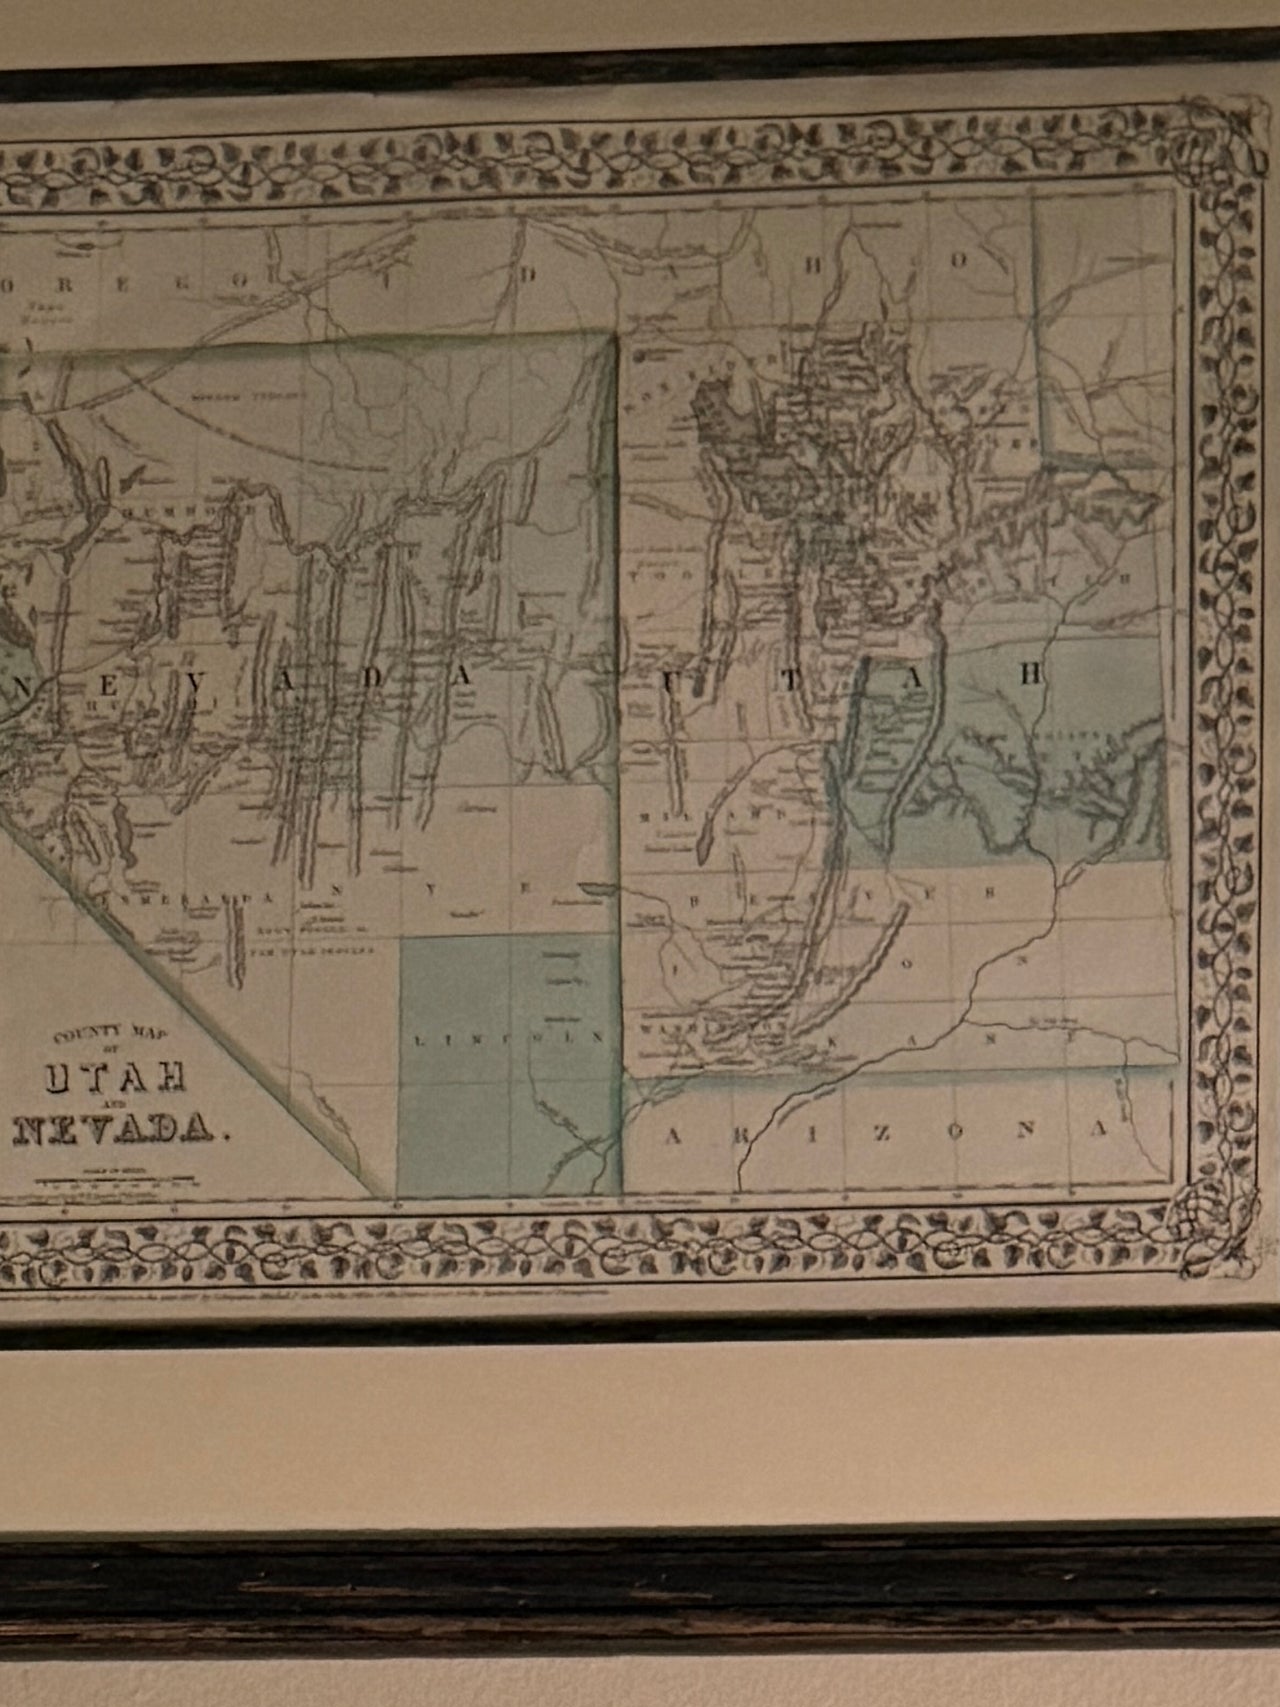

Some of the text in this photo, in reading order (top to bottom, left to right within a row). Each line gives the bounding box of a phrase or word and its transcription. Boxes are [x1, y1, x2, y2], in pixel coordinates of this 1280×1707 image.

[53, 1022, 169, 1045] COUNTY MAP
[103, 1046, 119, 1054] OF
[45, 1061, 187, 1094] UTAH
[103, 1100, 127, 1109] AND
